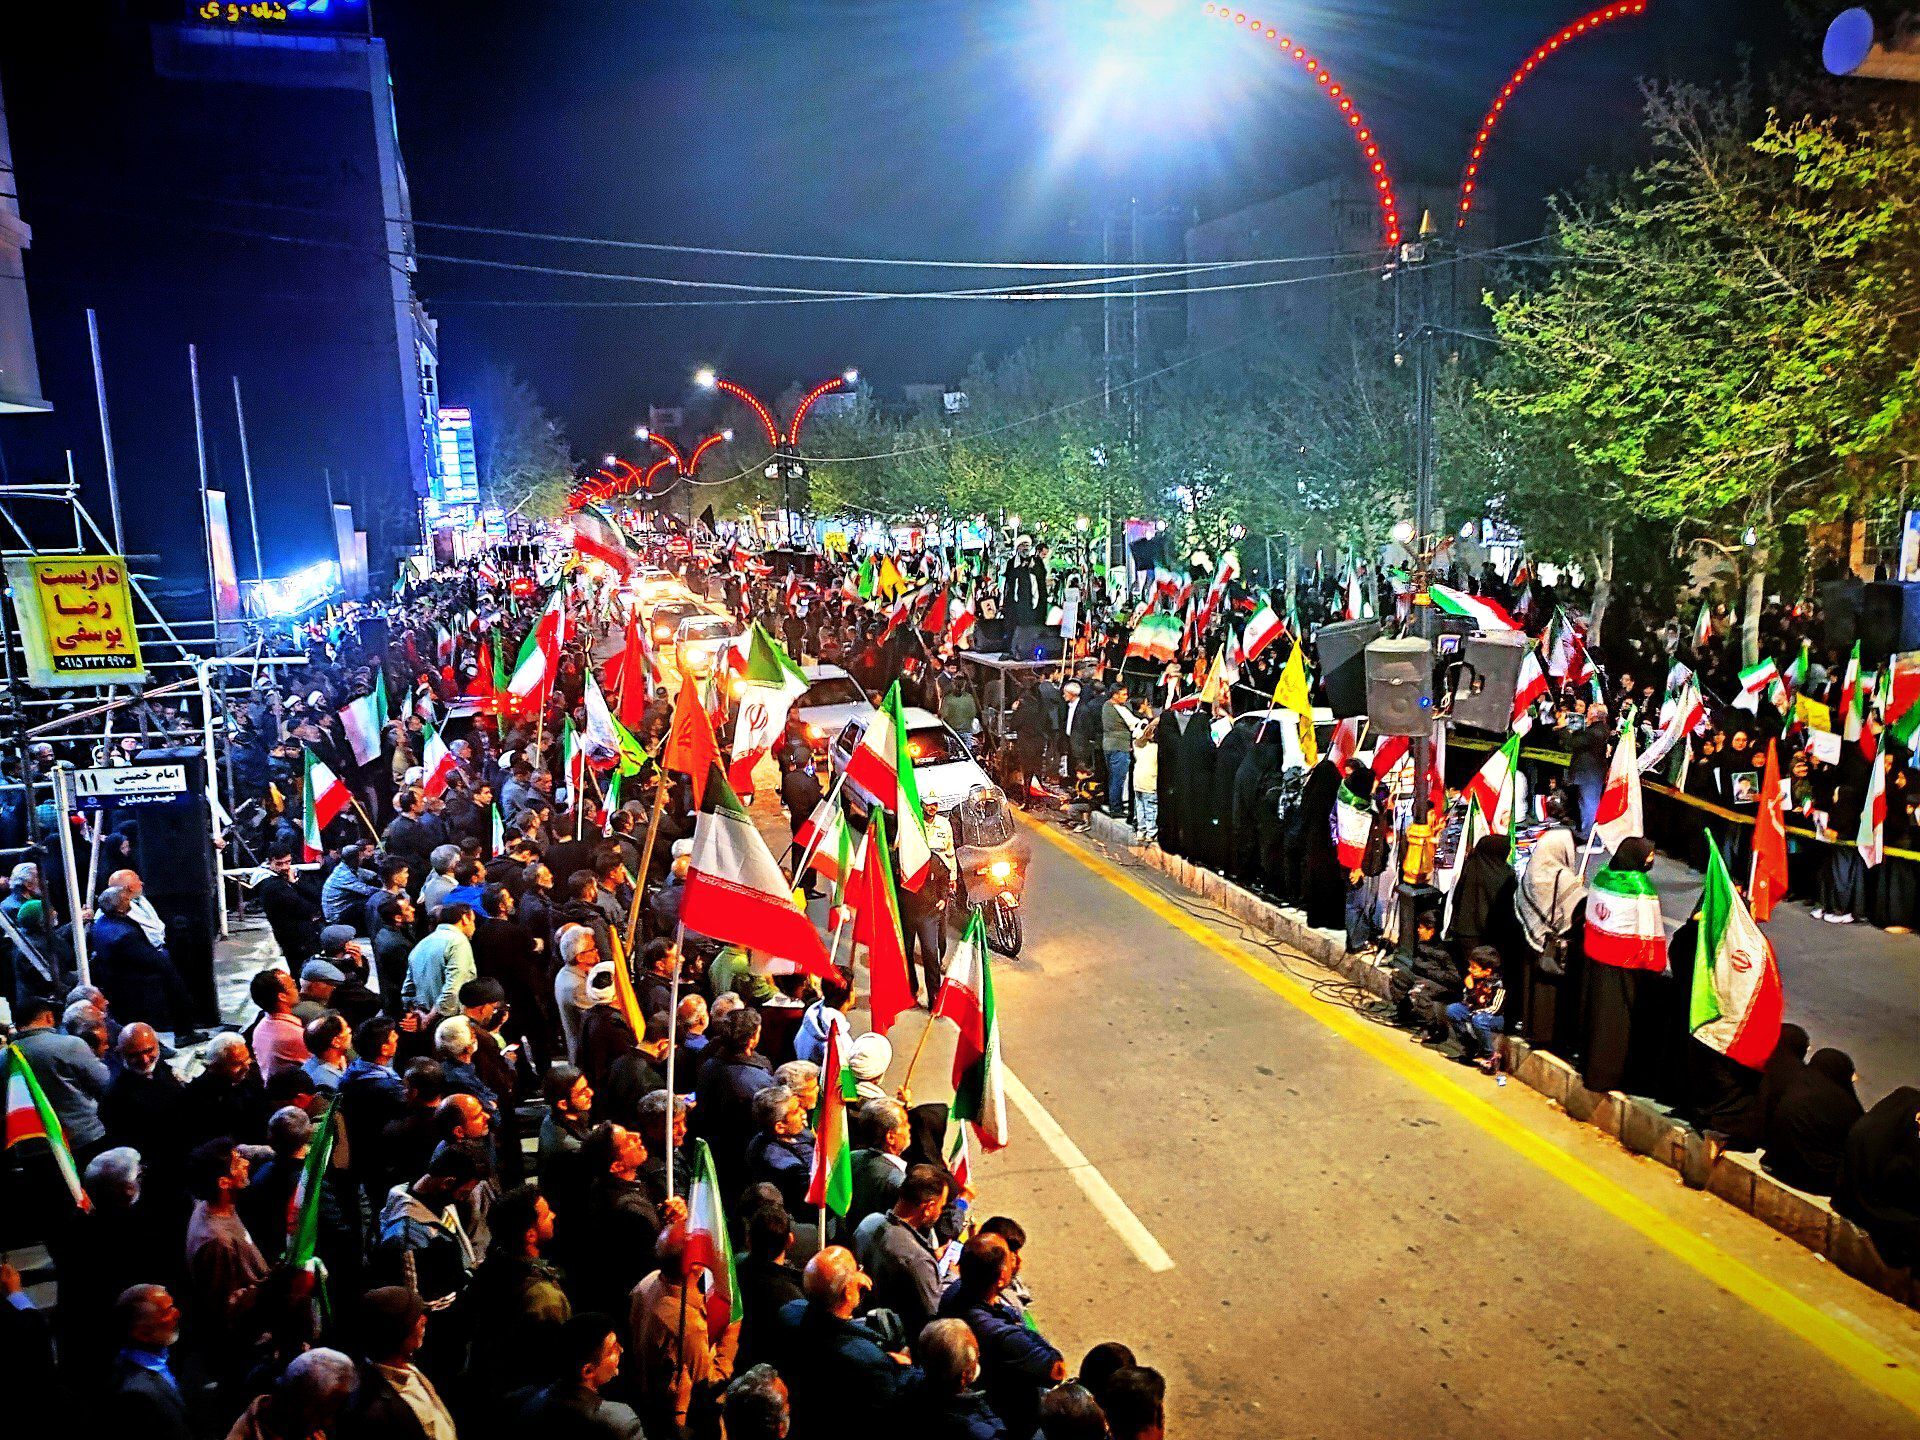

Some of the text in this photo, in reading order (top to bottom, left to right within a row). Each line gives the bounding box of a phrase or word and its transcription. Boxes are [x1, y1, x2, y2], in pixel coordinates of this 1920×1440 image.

[40, 564, 119, 590] داربست
[53, 594, 112, 619] رضا
[56, 620, 125, 650] یوسفی
[79, 773, 99, 792] ۱۱
[113, 769, 152, 785] خمینی
[156, 768, 179, 782] امام
